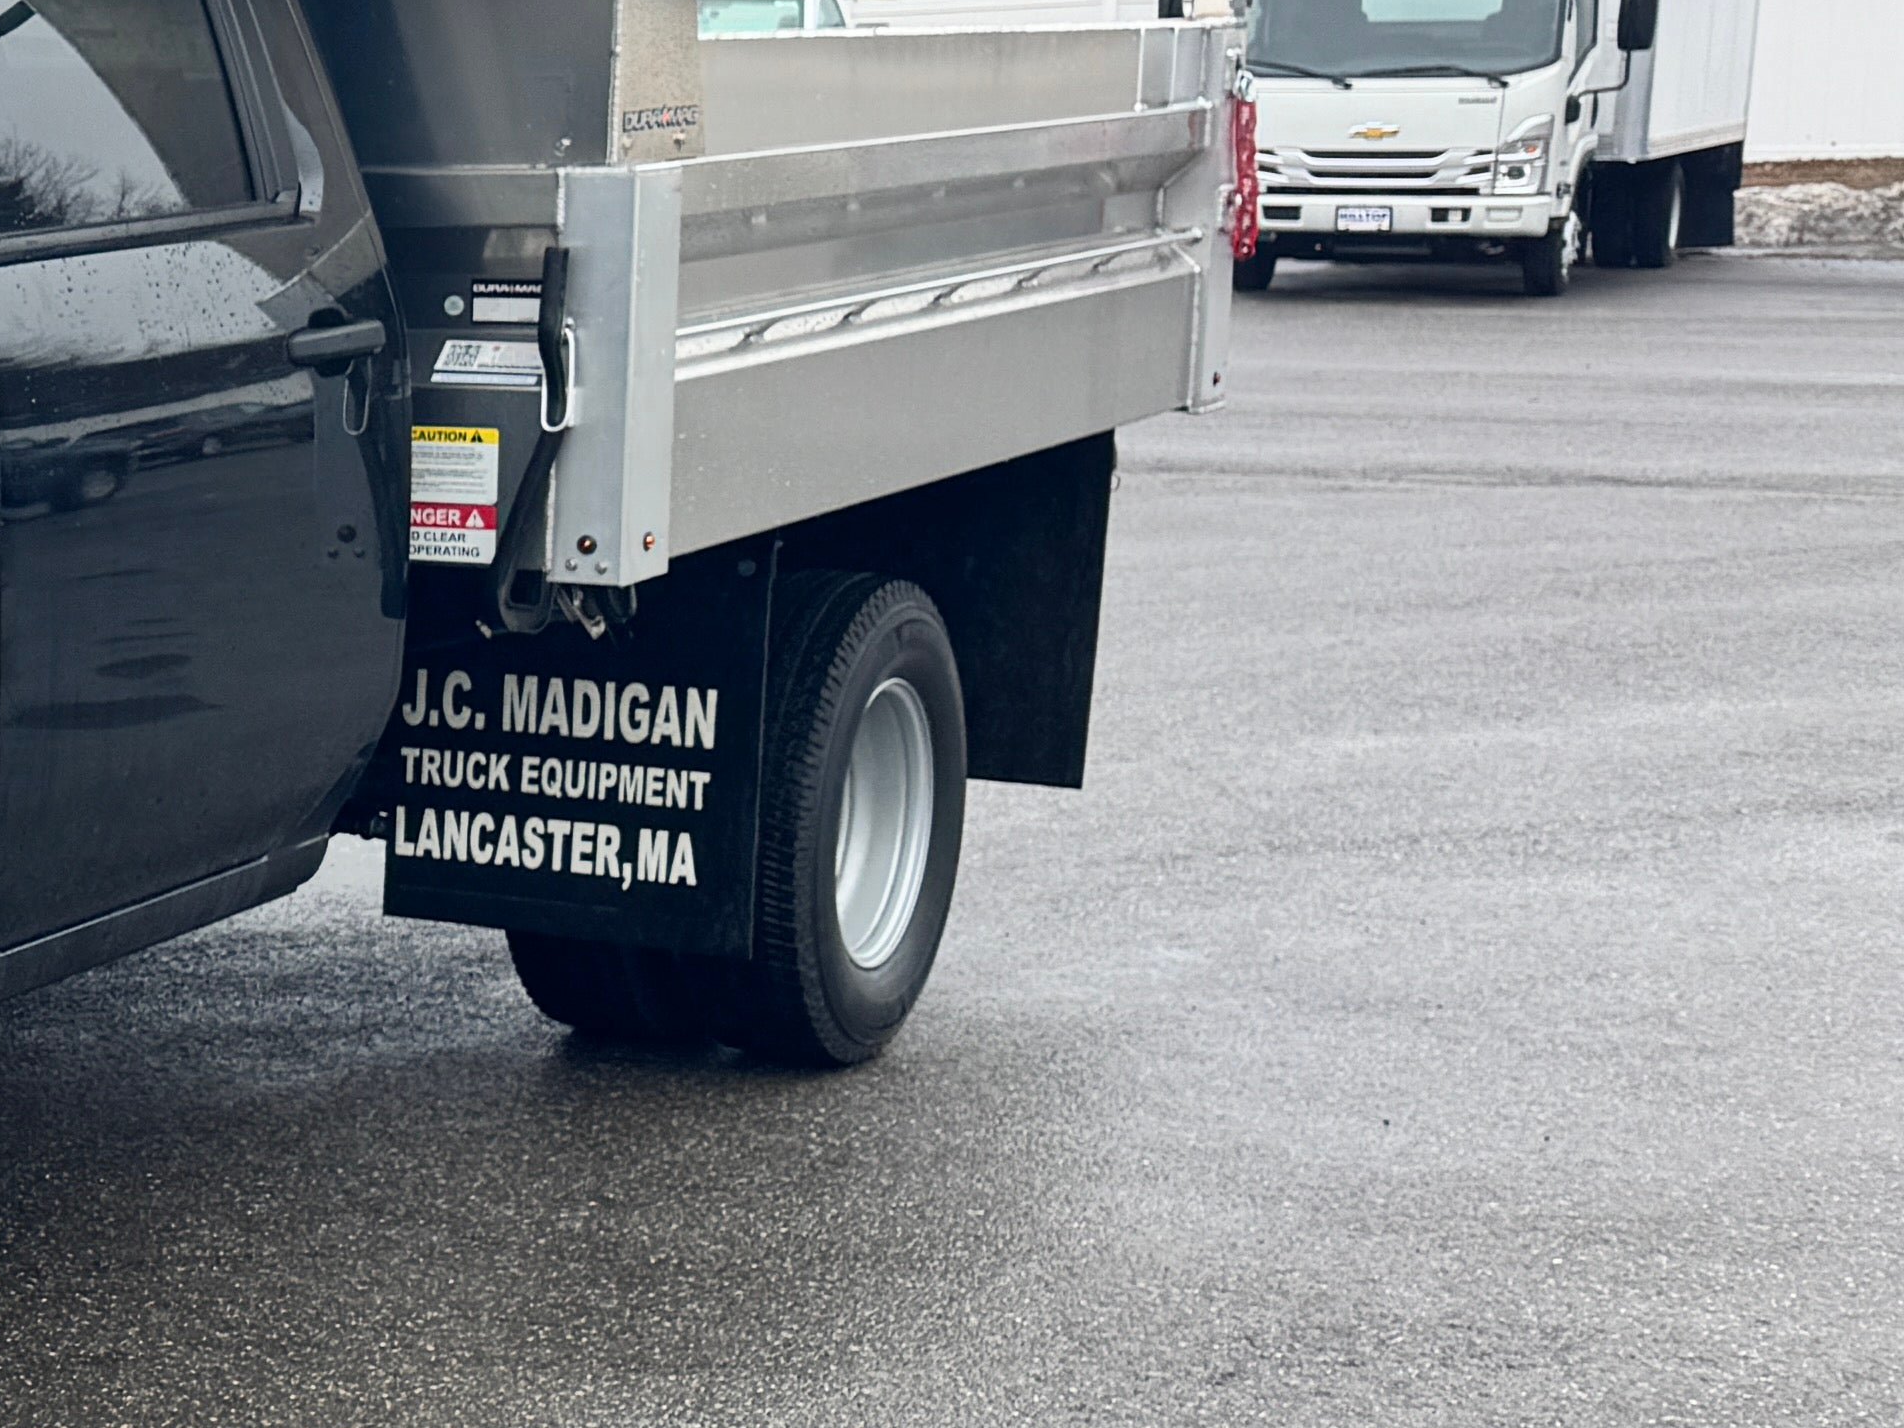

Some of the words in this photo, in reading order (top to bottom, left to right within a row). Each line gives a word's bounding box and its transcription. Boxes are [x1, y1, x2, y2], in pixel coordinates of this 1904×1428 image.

[410, 508, 461, 526] NGER
[423, 531, 466, 543] CLEAR
[402, 669, 486, 730] J.C.
[501, 673, 718, 750] MADIGAN
[400, 746, 512, 792] TRUCK
[520, 755, 712, 811] EQUIPMENT
[394, 805, 698, 891] LANCASTER,MA
